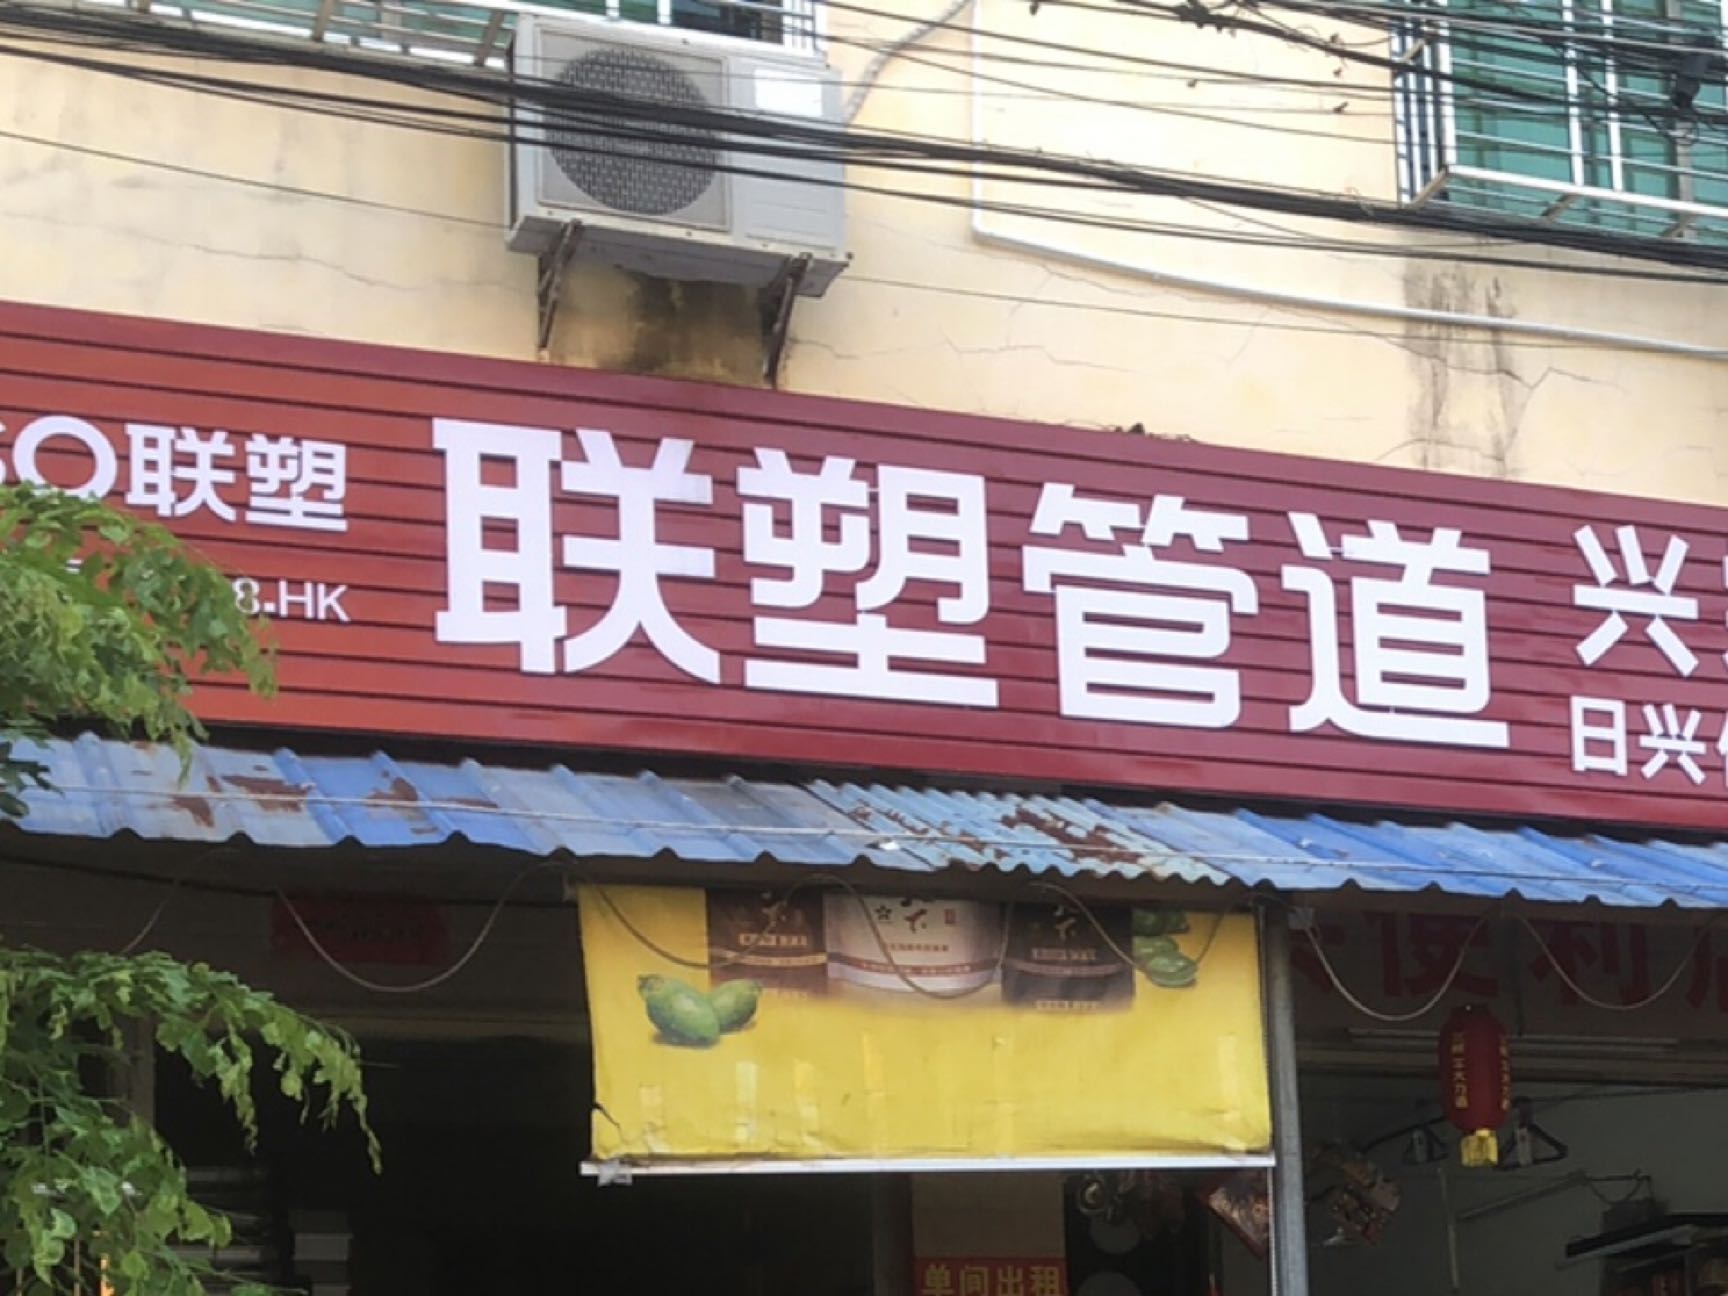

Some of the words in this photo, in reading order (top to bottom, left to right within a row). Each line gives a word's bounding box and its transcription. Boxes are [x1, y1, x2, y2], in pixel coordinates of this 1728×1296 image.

[124, 423, 348, 532] 联塑
[432, 416, 1511, 750] 联塑管道
